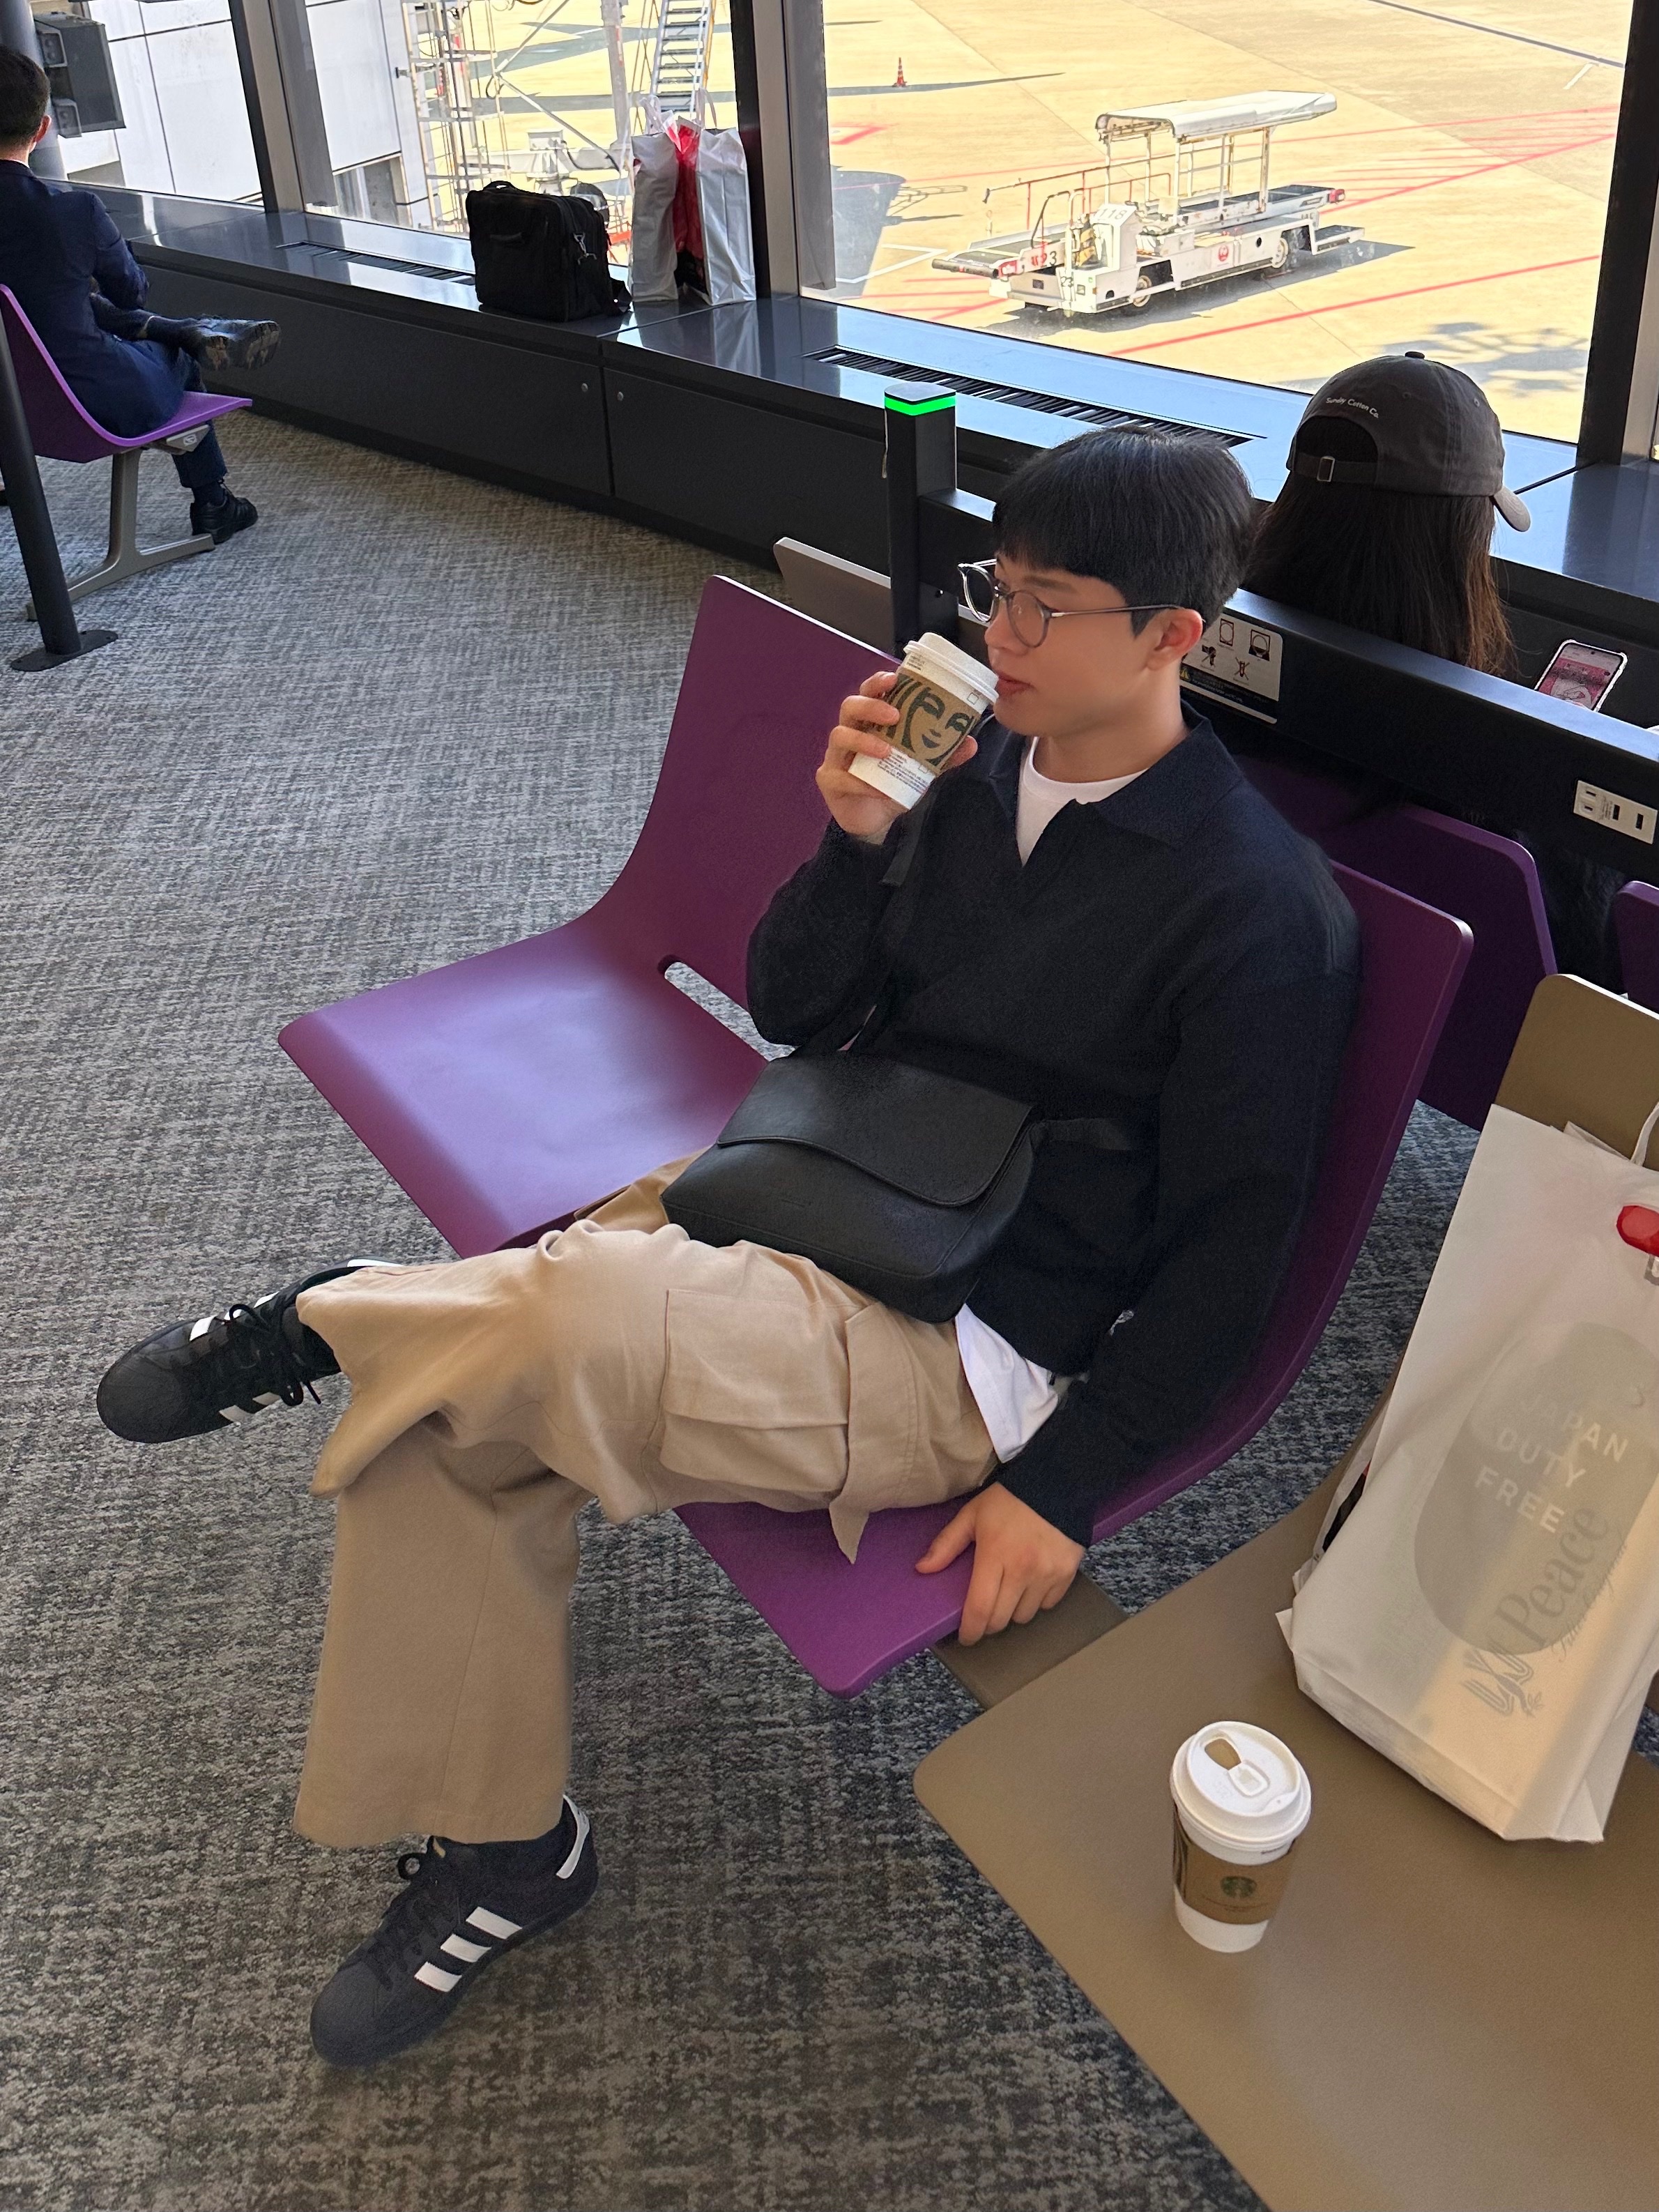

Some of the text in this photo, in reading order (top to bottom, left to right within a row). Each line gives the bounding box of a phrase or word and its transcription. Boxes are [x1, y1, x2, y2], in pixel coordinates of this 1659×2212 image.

[1347, 398, 1369, 411] Cotton
[1496, 1426, 1587, 1488] DUTY
[1474, 1465, 1565, 1533] FREE
[1494, 1507, 1609, 1649] Peace
